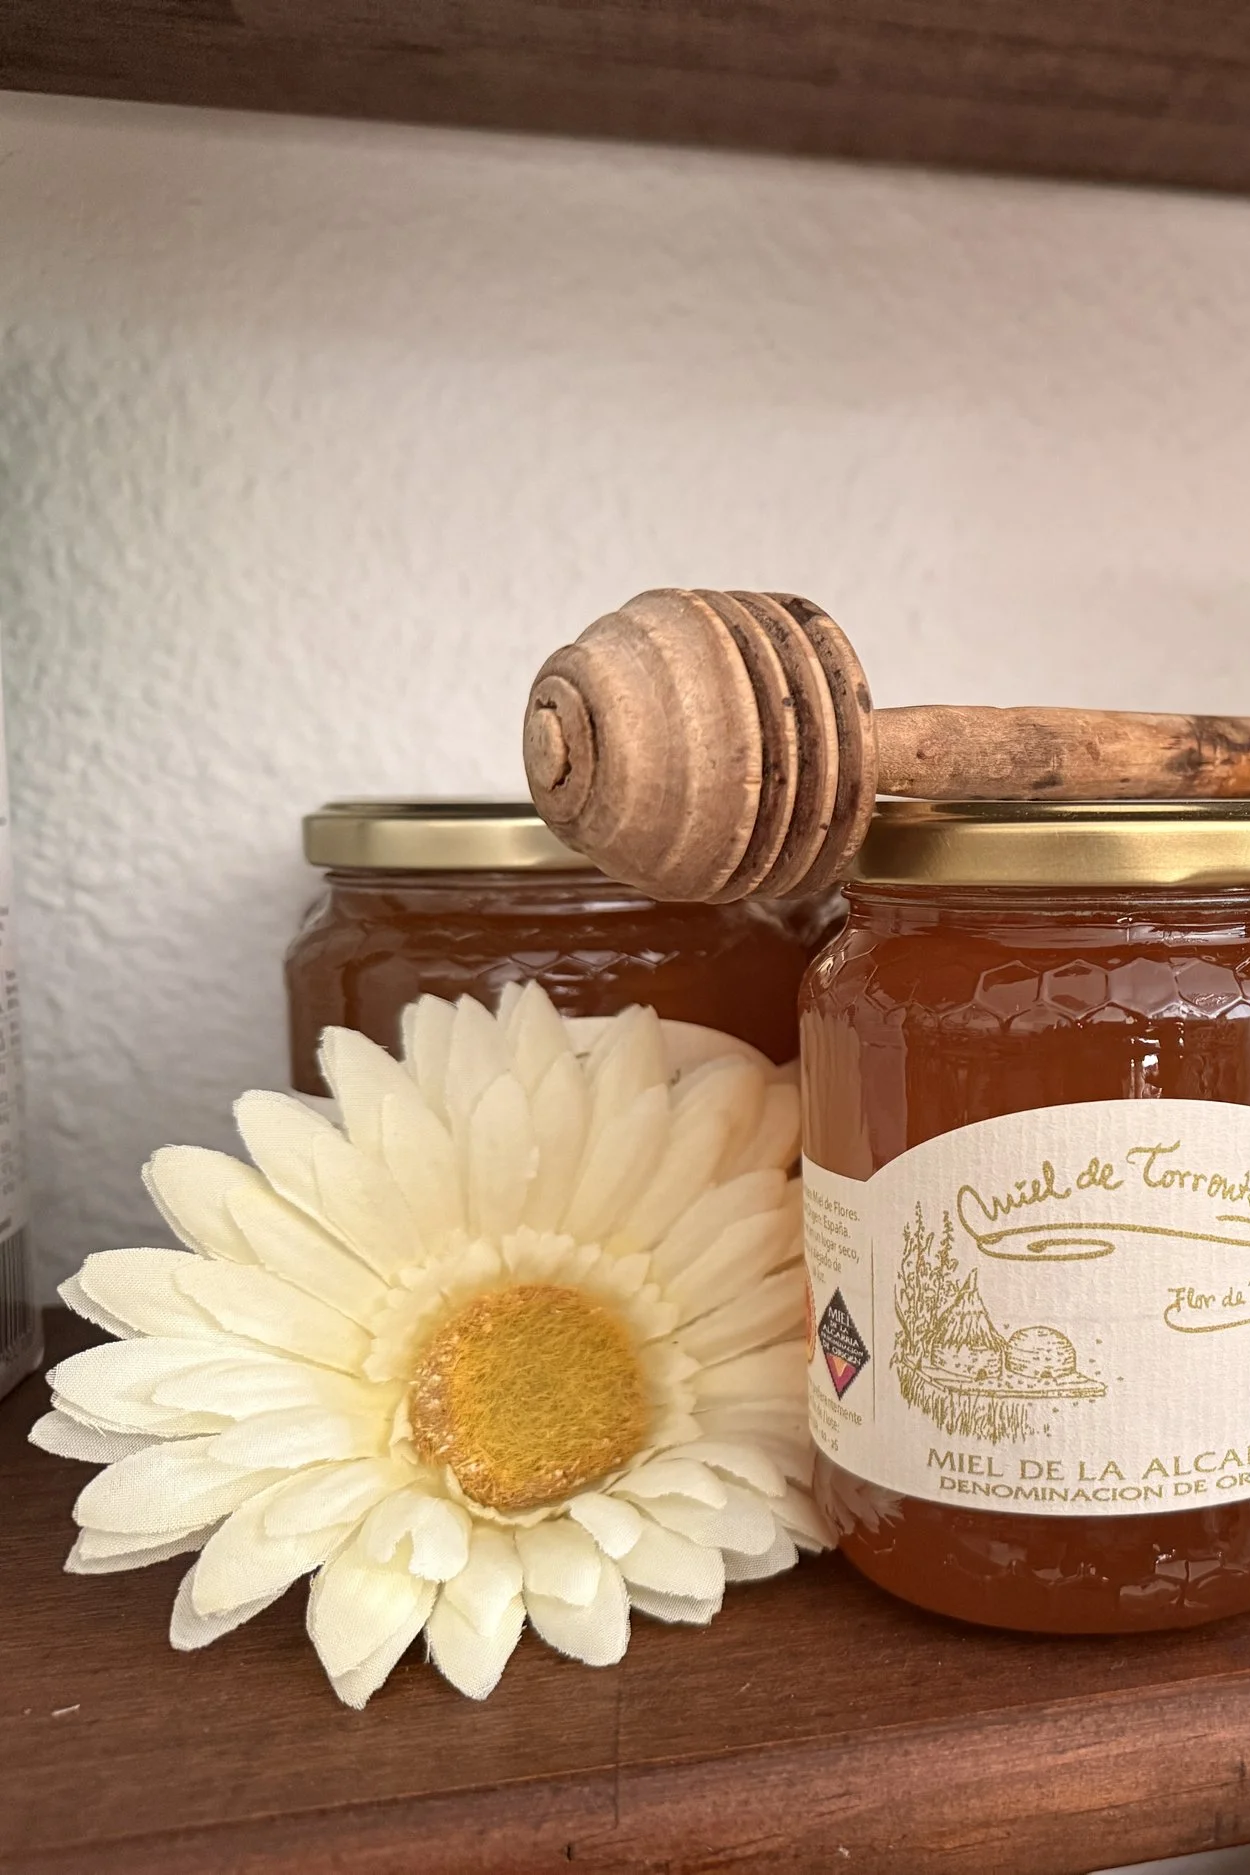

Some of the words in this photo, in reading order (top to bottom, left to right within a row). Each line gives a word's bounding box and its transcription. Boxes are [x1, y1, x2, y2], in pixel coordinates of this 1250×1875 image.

[957, 1161, 1071, 1222] Miel
[1070, 1156, 1124, 1190] de
[834, 1201, 860, 1222] Flores.
[1168, 1287, 1216, 1313] Flor
[1221, 1286, 1246, 1306] de
[828, 1306, 850, 1328] MIEL
[822, 1323, 859, 1348] ALCARRIA
[925, 1448, 1003, 1480] MIEL
[1019, 1459, 1070, 1481] DE
[1078, 1460, 1126, 1482] LA
[939, 1475, 1164, 1503] DENOMINACION
[1173, 1482, 1208, 1497] DE
